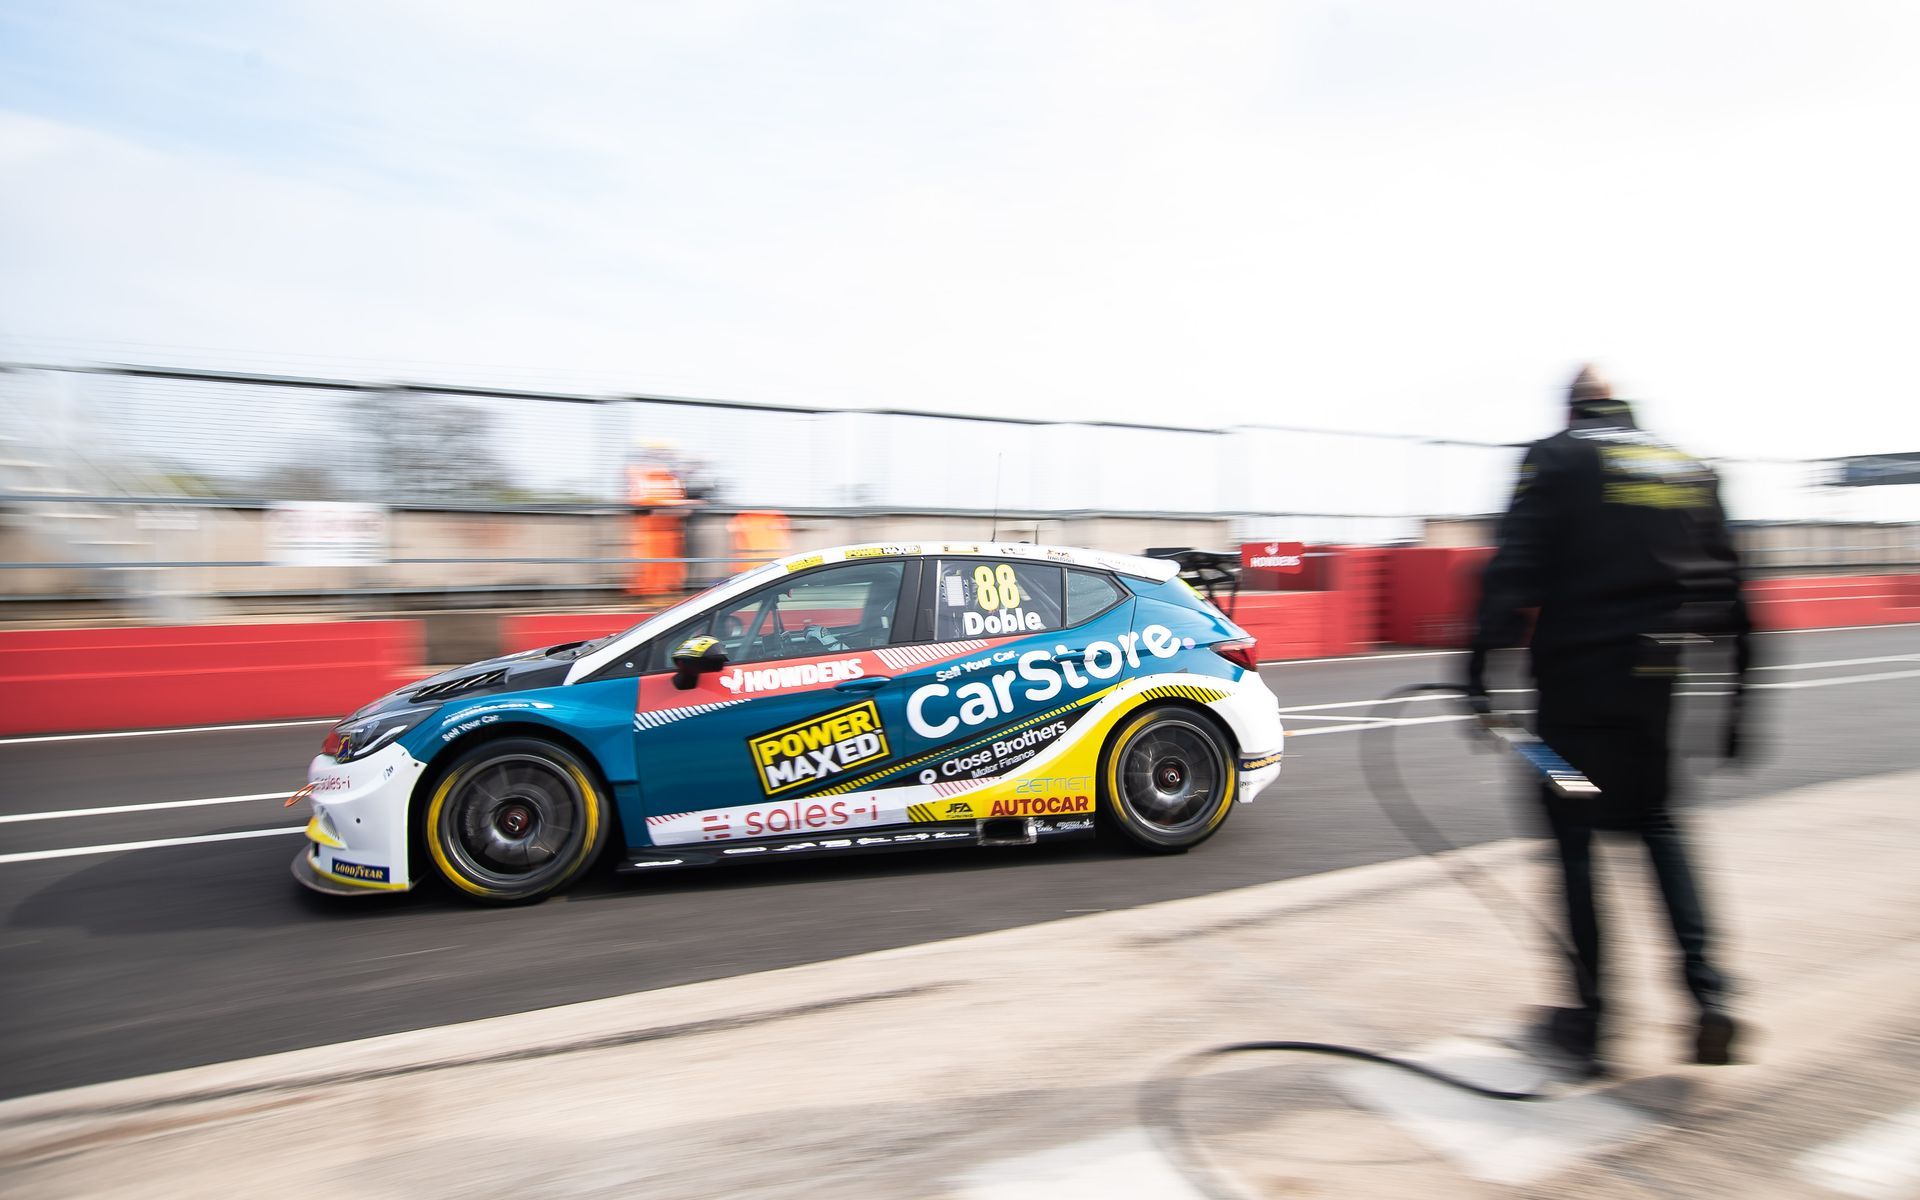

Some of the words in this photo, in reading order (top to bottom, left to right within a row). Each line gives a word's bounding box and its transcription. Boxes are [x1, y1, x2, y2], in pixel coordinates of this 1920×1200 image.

[974, 564, 1020, 611] 88
[962, 607, 1041, 636] Doble
[744, 659, 864, 693] HOWDENS
[936, 665, 961, 681] Sell
[961, 657, 991, 672] Your
[441, 728, 460, 742] Sell
[758, 710, 876, 765] POWER
[941, 750, 992, 776] Close
[993, 721, 1068, 758] Brothers
[764, 733, 881, 788] MAXED
[971, 762, 999, 779] Motor
[1000, 749, 1035, 769] Finance
[745, 797, 878, 836] sales-i
[945, 803, 973, 813] JFA
[990, 796, 1089, 816] AUTOCAR
